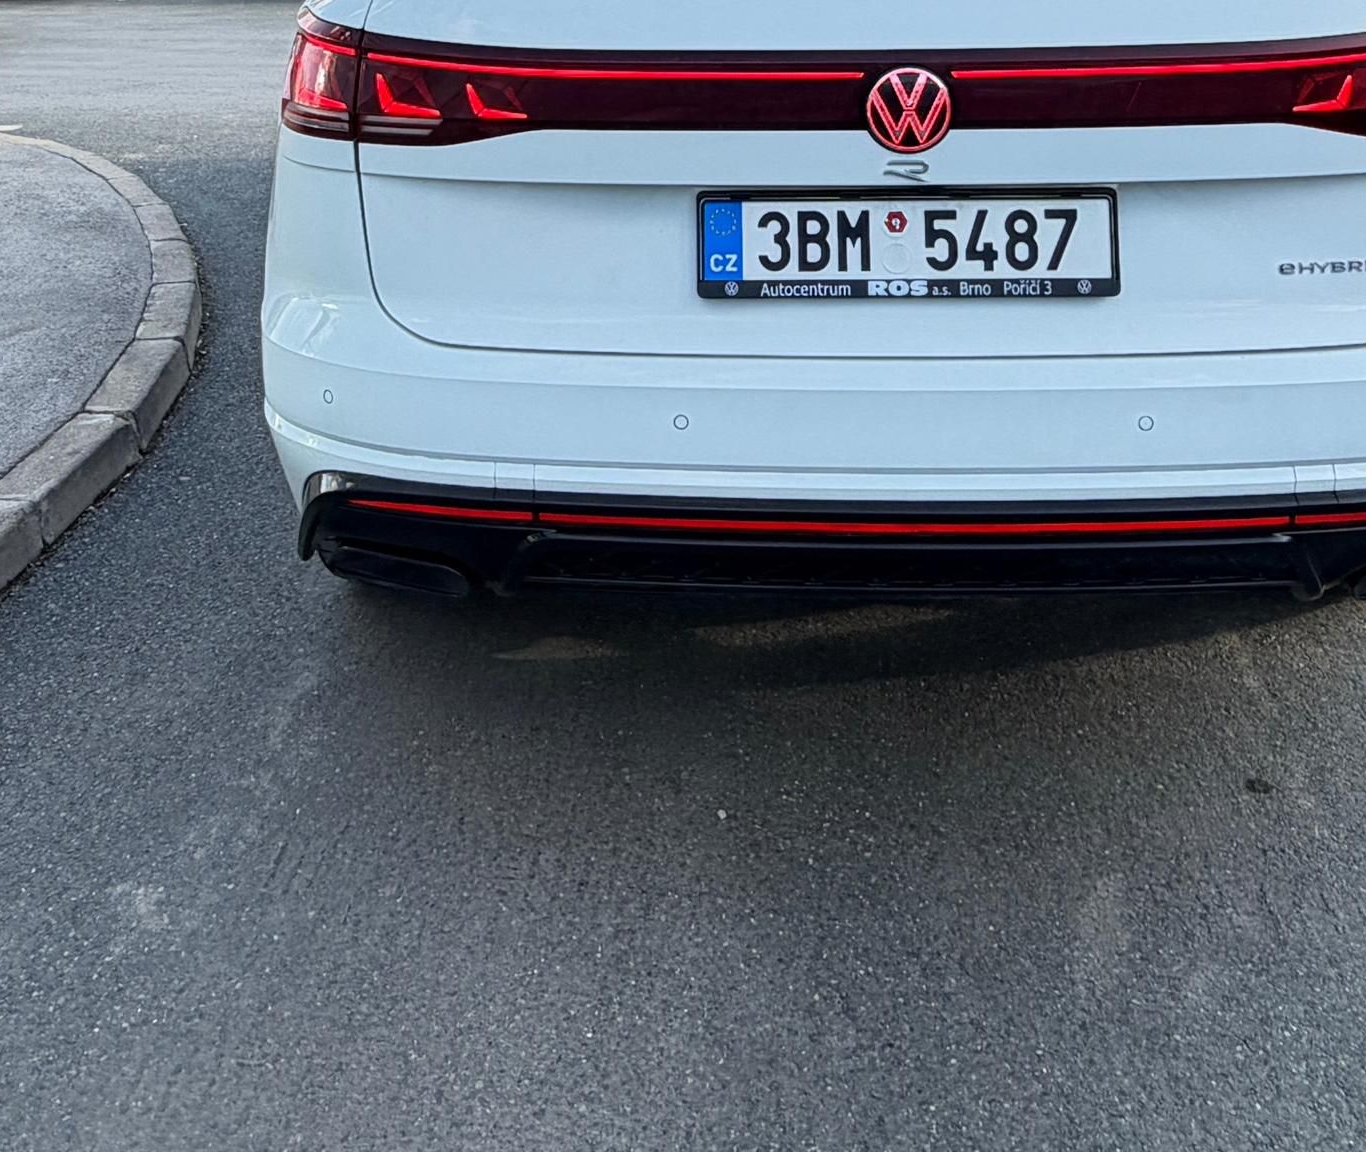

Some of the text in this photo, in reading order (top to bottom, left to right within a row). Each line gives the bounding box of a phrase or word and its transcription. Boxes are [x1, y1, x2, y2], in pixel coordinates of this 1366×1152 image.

[757, 209, 1078, 272] 3BM 5487
[709, 254, 738, 273] CZ
[761, 281, 852, 297] Autocentrum
[867, 280, 928, 296] ROS
[932, 285, 952, 296] a.s.
[959, 281, 992, 296] Brno
[1003, 279, 1041, 296] Poříčí
[1043, 281, 1052, 295] 3
